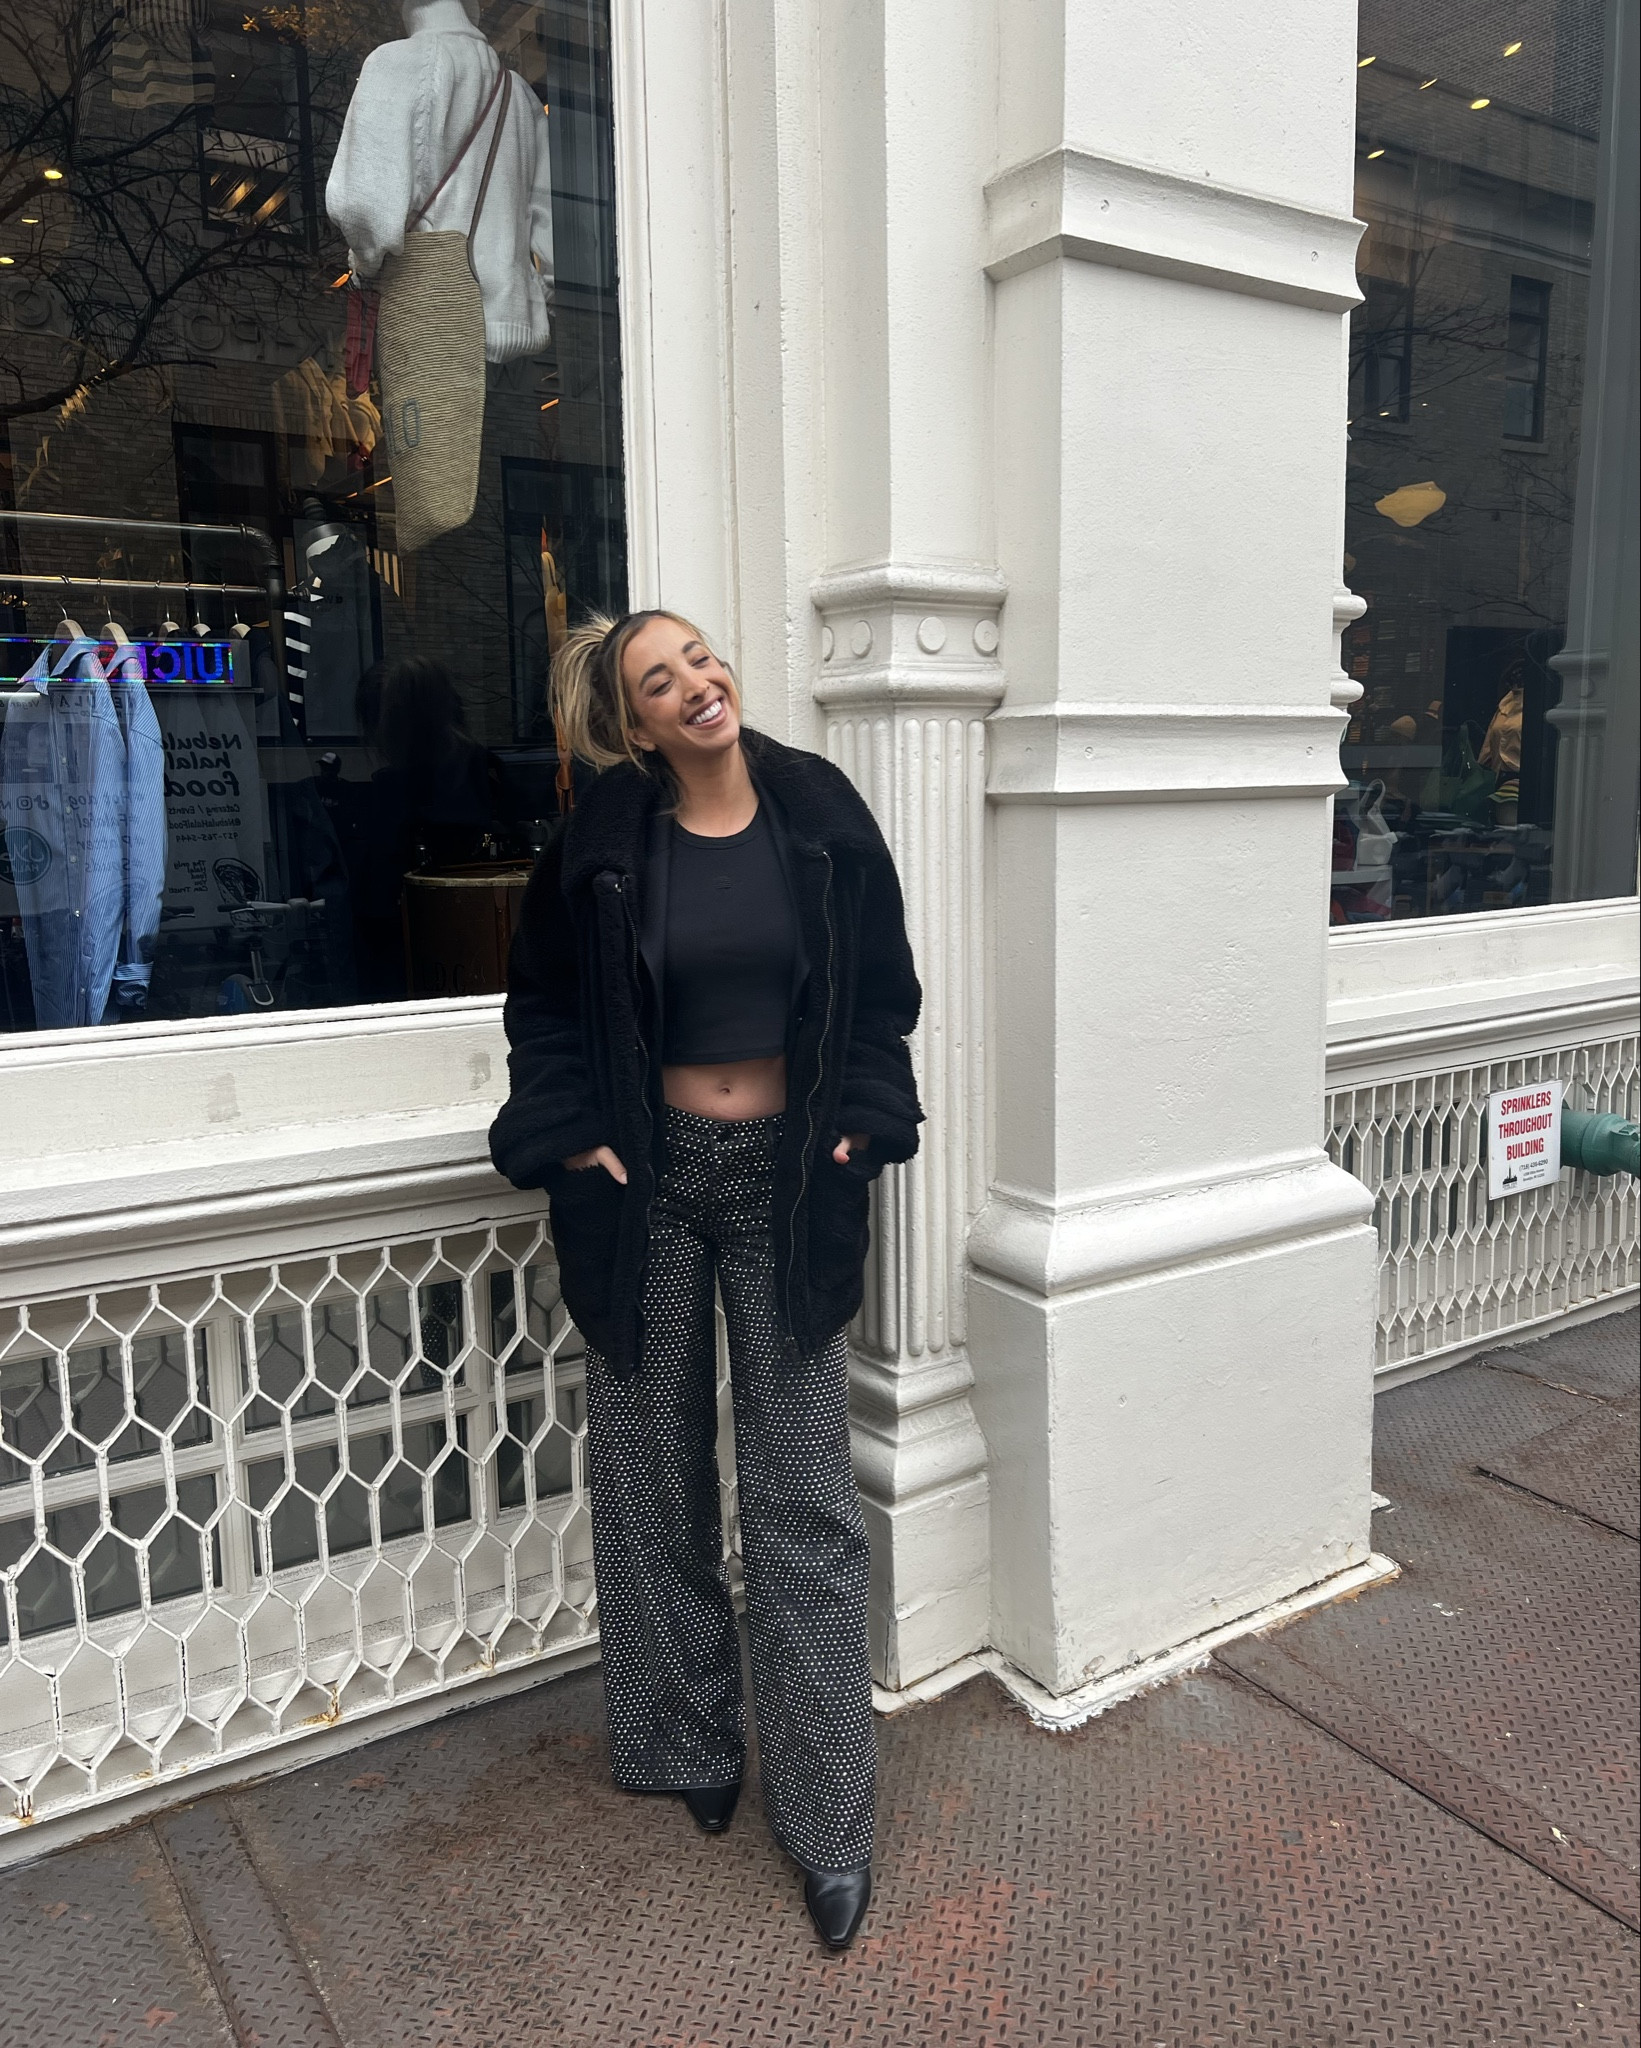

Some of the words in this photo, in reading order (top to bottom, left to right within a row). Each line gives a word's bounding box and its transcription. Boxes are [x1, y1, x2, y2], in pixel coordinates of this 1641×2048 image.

[1500, 1090, 1552, 1116] SPRINKLERS
[1498, 1112, 1553, 1139] THROUGHOUT
[1506, 1137, 1545, 1161] BUILDING
